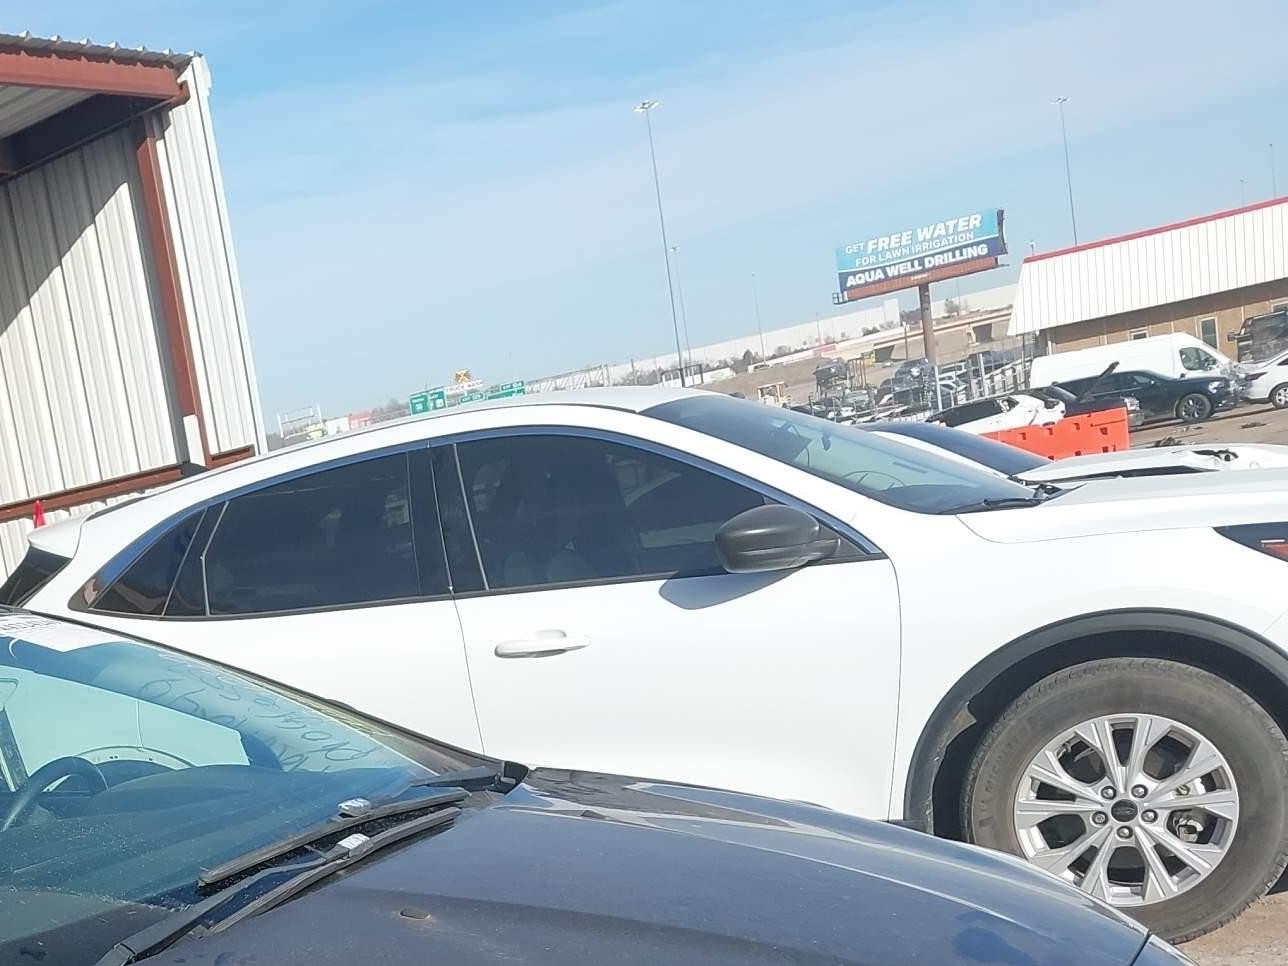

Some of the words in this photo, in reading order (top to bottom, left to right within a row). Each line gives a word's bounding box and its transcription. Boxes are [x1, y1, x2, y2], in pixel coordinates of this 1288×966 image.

[845, 242, 865, 254] GET
[867, 229, 913, 254] FREE
[917, 213, 982, 242] WATER
[855, 255, 877, 268] FOR
[879, 246, 911, 263] LAWN
[911, 231, 975, 254] IRRIGATION
[846, 268, 885, 288] AQUA
[885, 259, 924, 278] WELL
[924, 243, 989, 269] DRILLING
